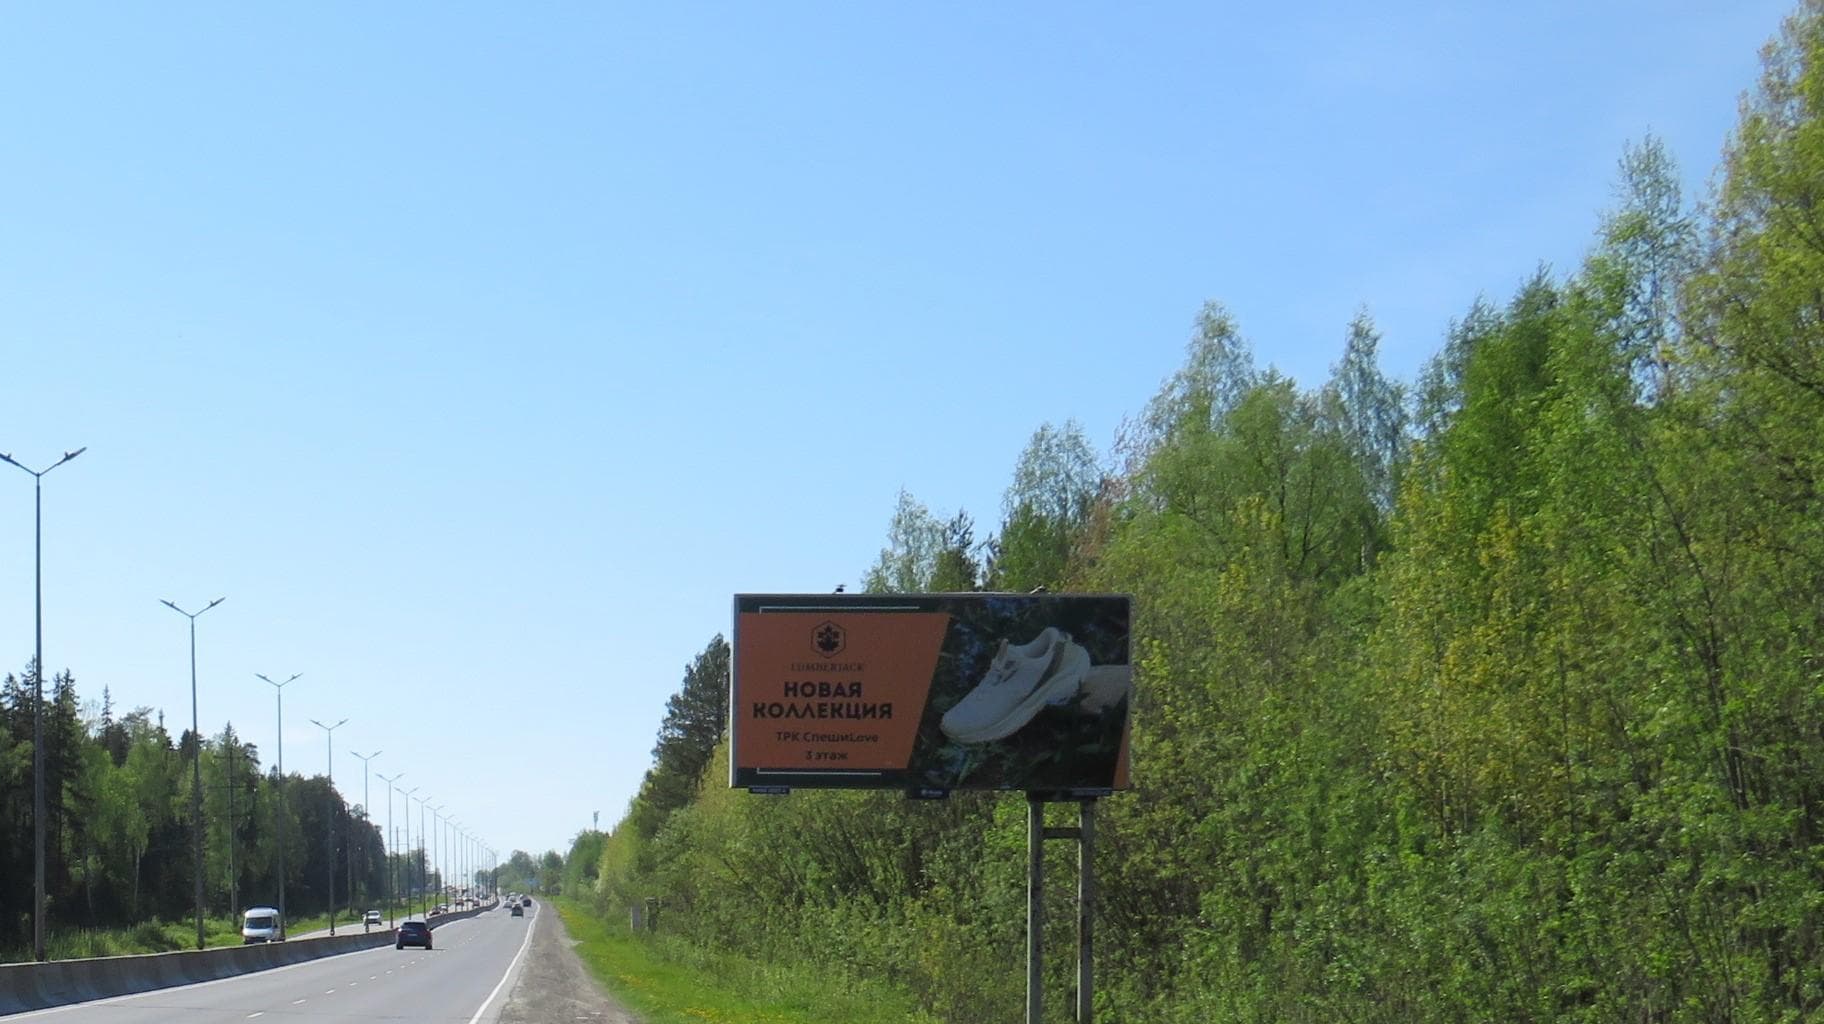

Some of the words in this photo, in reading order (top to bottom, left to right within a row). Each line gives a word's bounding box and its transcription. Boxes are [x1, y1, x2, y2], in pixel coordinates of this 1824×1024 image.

[784, 681, 862, 698] НОВАЯ
[753, 702, 892, 720] КОЛЛЕКЦИЯ
[776, 731, 800, 742] ТРК
[805, 751, 812, 760] 3
[815, 751, 848, 761] этаж
